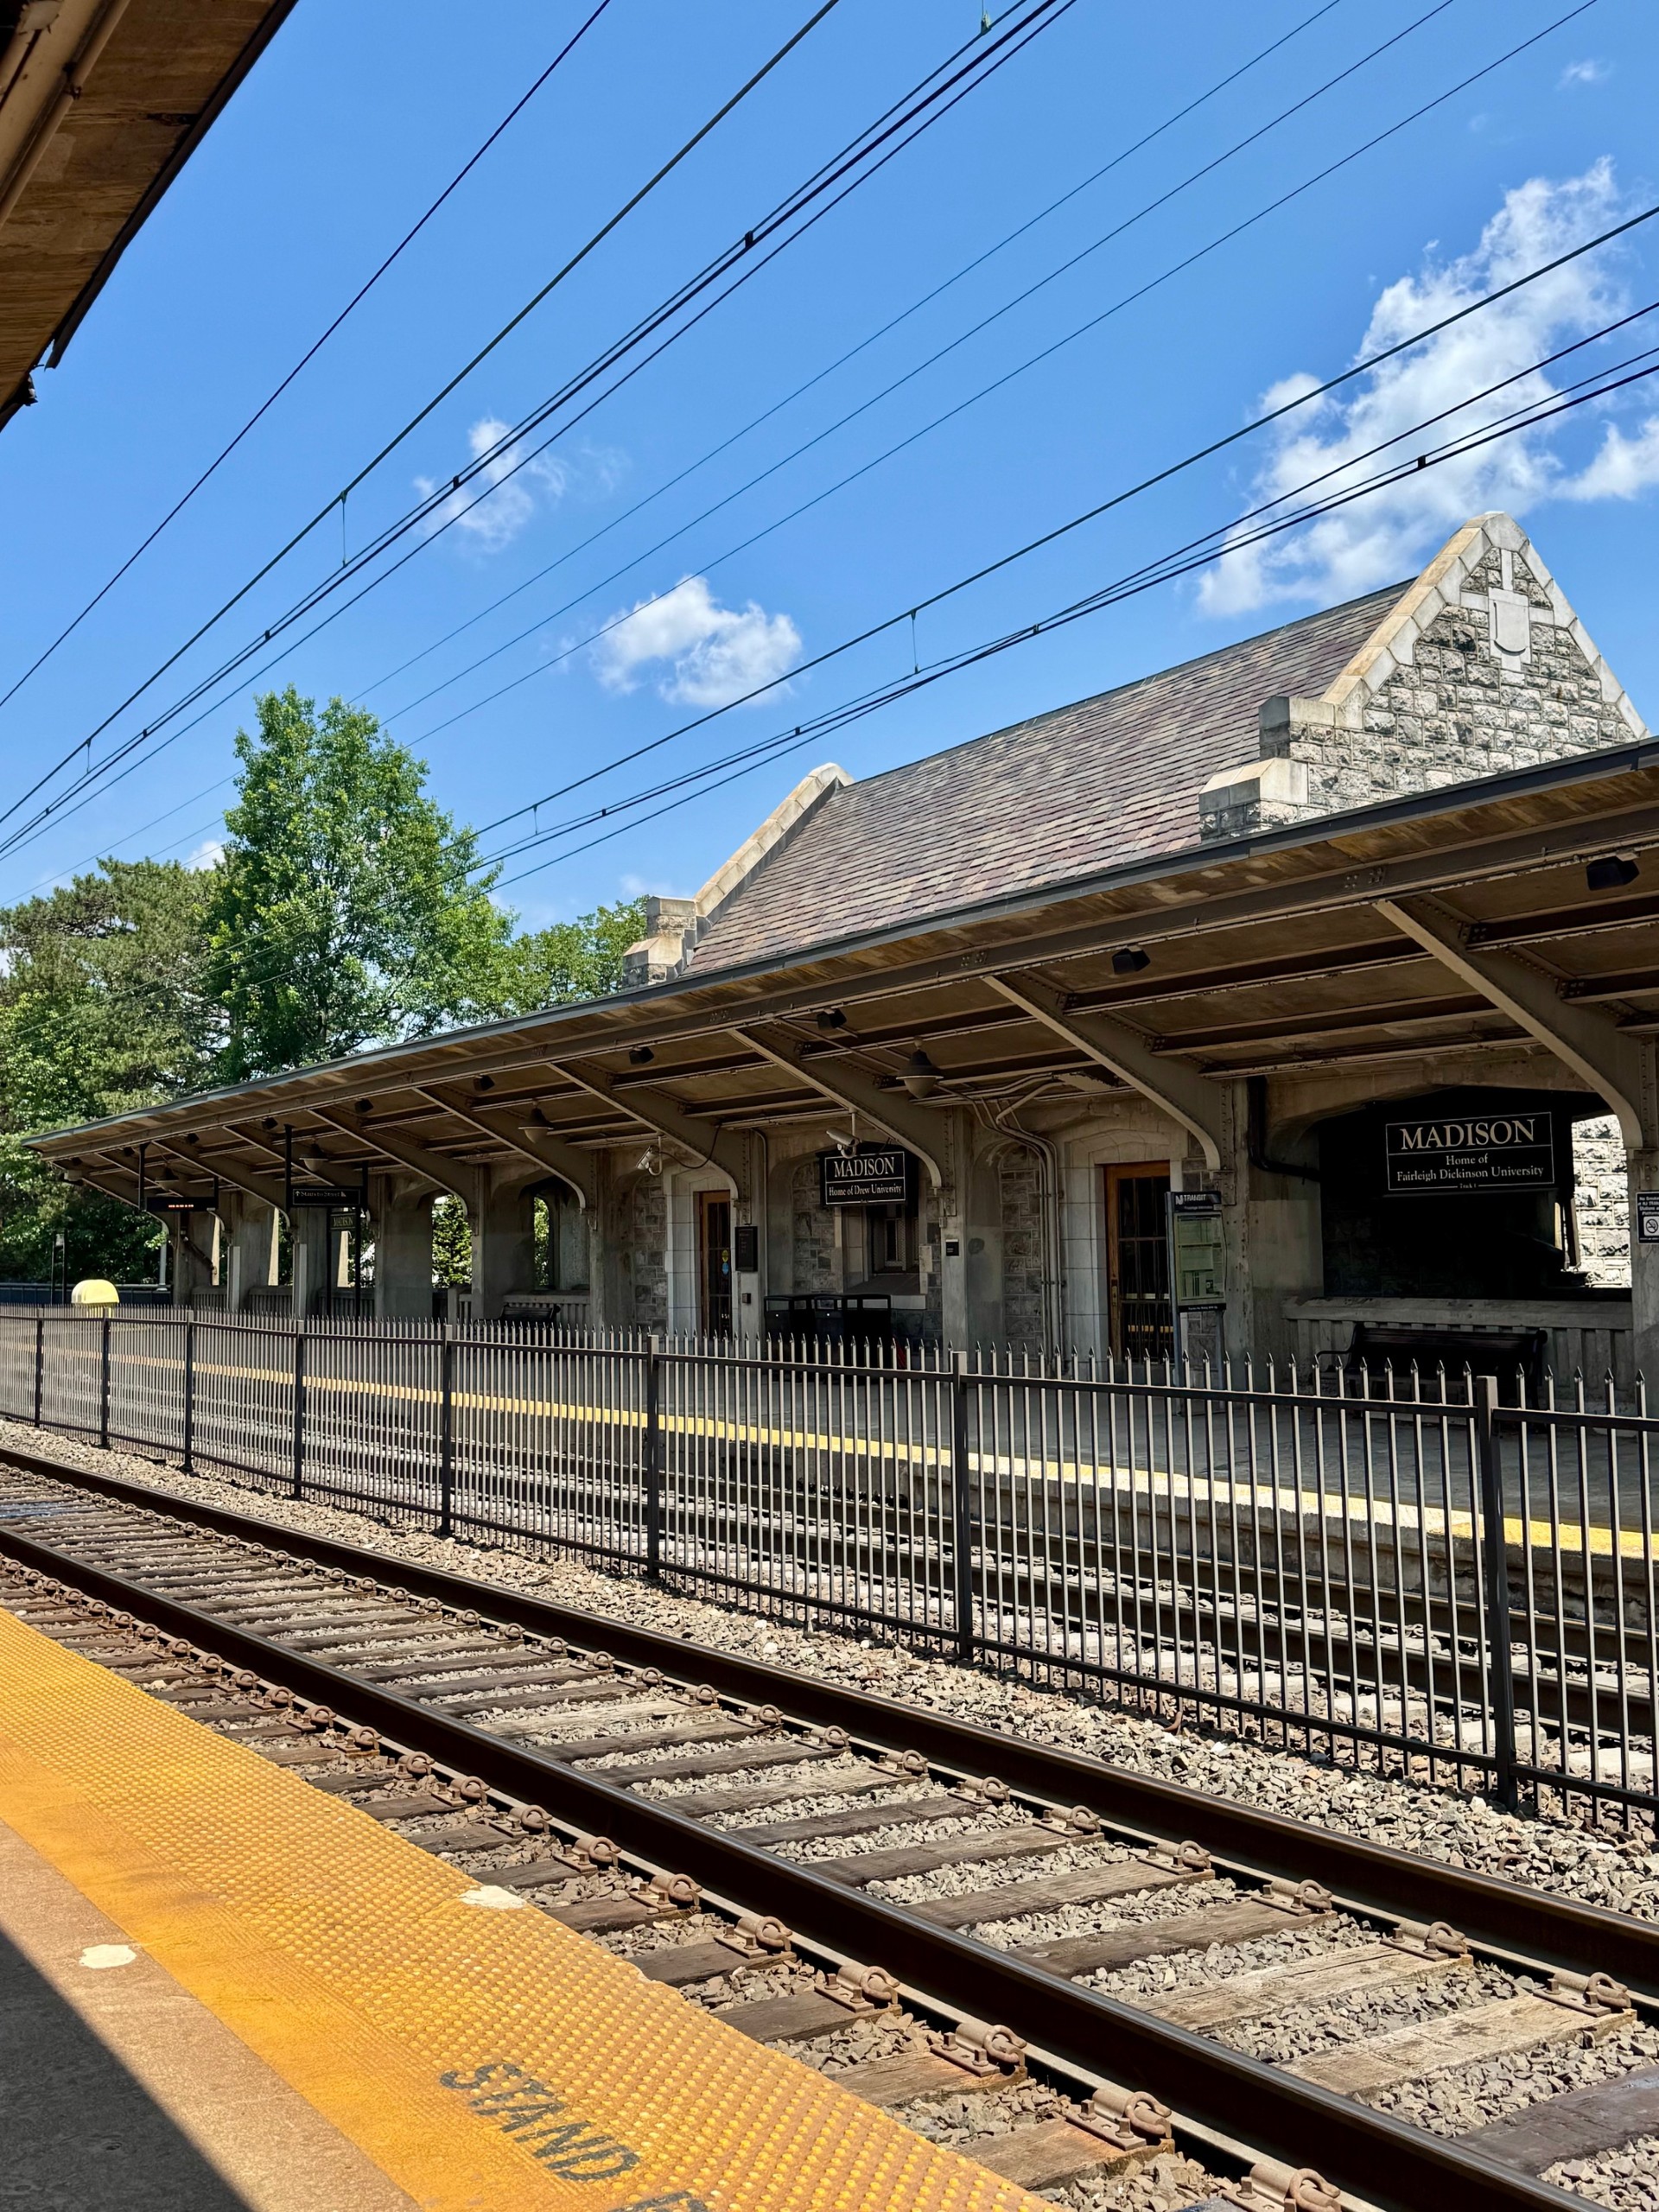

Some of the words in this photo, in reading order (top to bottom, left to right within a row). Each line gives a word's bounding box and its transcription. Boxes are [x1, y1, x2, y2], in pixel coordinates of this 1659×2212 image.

[1400, 1119, 1535, 1150] MADISON
[834, 1157, 895, 1178] MADISON
[1446, 1154, 1476, 1166] Home
[1478, 1154, 1489, 1164] of
[1397, 1169, 1437, 1182] Fairleigh
[1440, 1167, 1489, 1179] Dickinson
[1491, 1166, 1544, 1178] University
[829, 1186, 846, 1197] Home
[847, 1185, 854, 1196] of
[854, 1185, 870, 1195] Drew
[871, 1183, 902, 1194] University
[1184, 1193, 1207, 1202] TRANSIT
[439, 2062, 641, 2183] STAND
